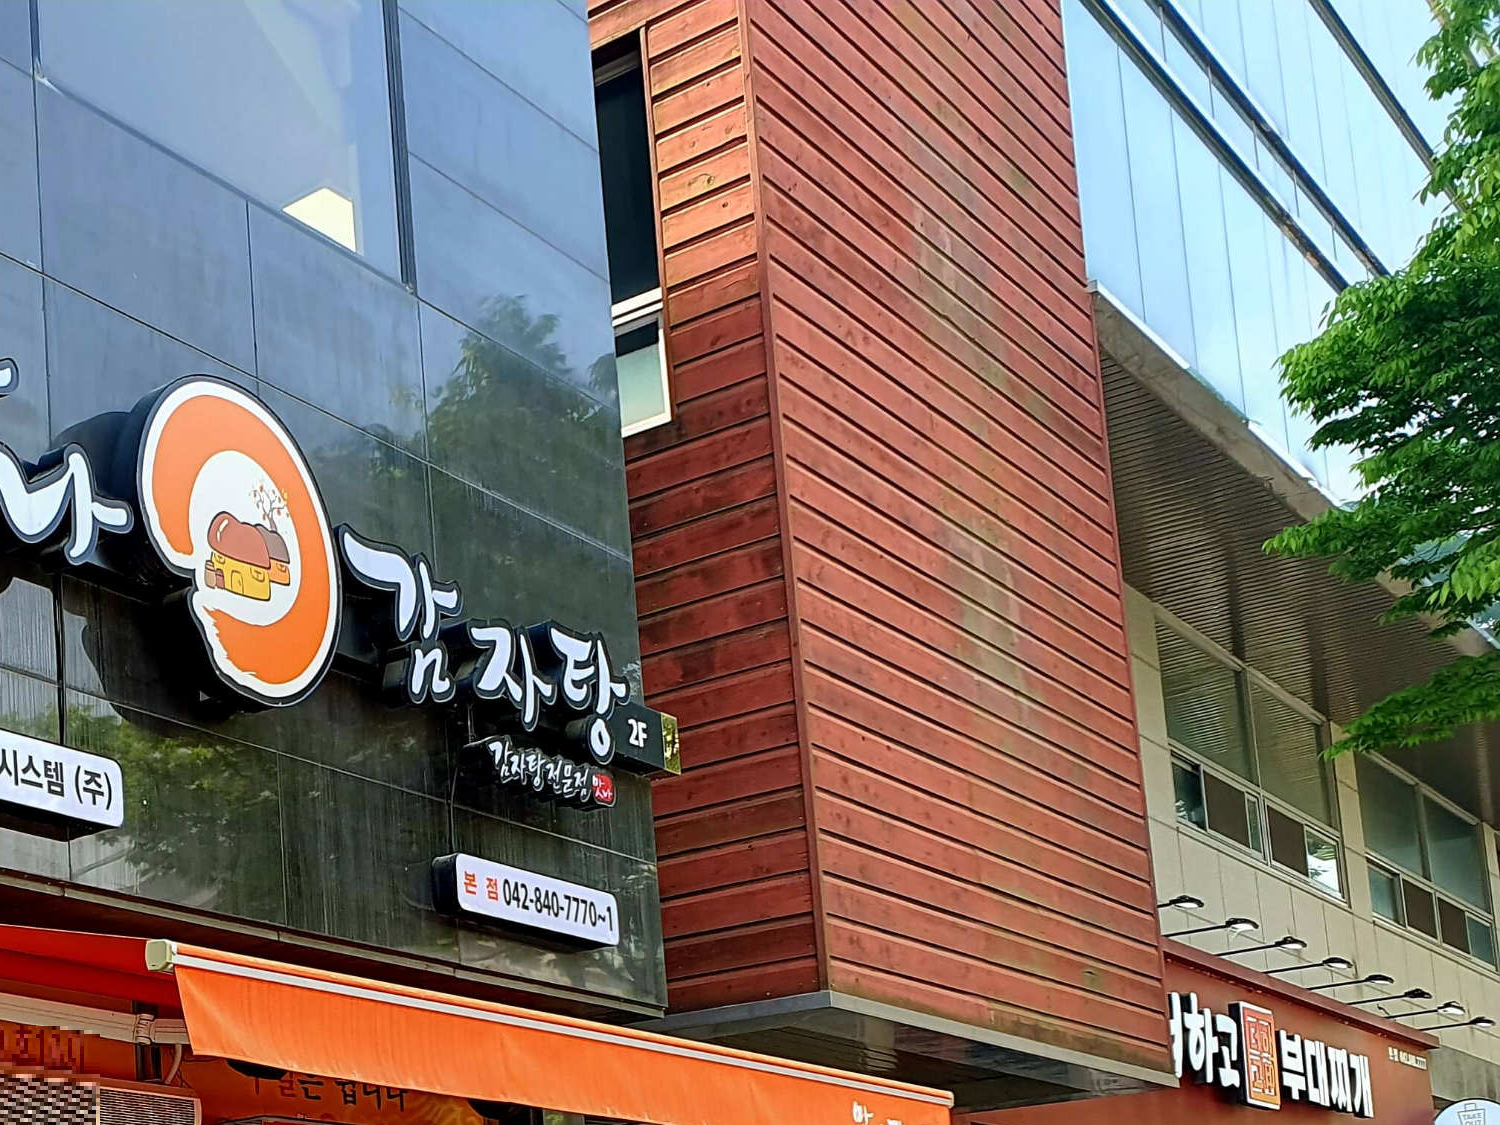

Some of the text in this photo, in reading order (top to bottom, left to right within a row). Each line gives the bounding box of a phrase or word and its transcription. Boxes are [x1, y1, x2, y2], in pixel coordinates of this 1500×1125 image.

[343, 531, 628, 756] 감자탕
[628, 718, 648, 748] 2F
[74, 753, 113, 810] (주)
[502, 881, 613, 932] 042-840-7770~1
[1280, 1029, 1374, 1118] 부대찌개
[1462, 1112, 1483, 1120] TAKE
